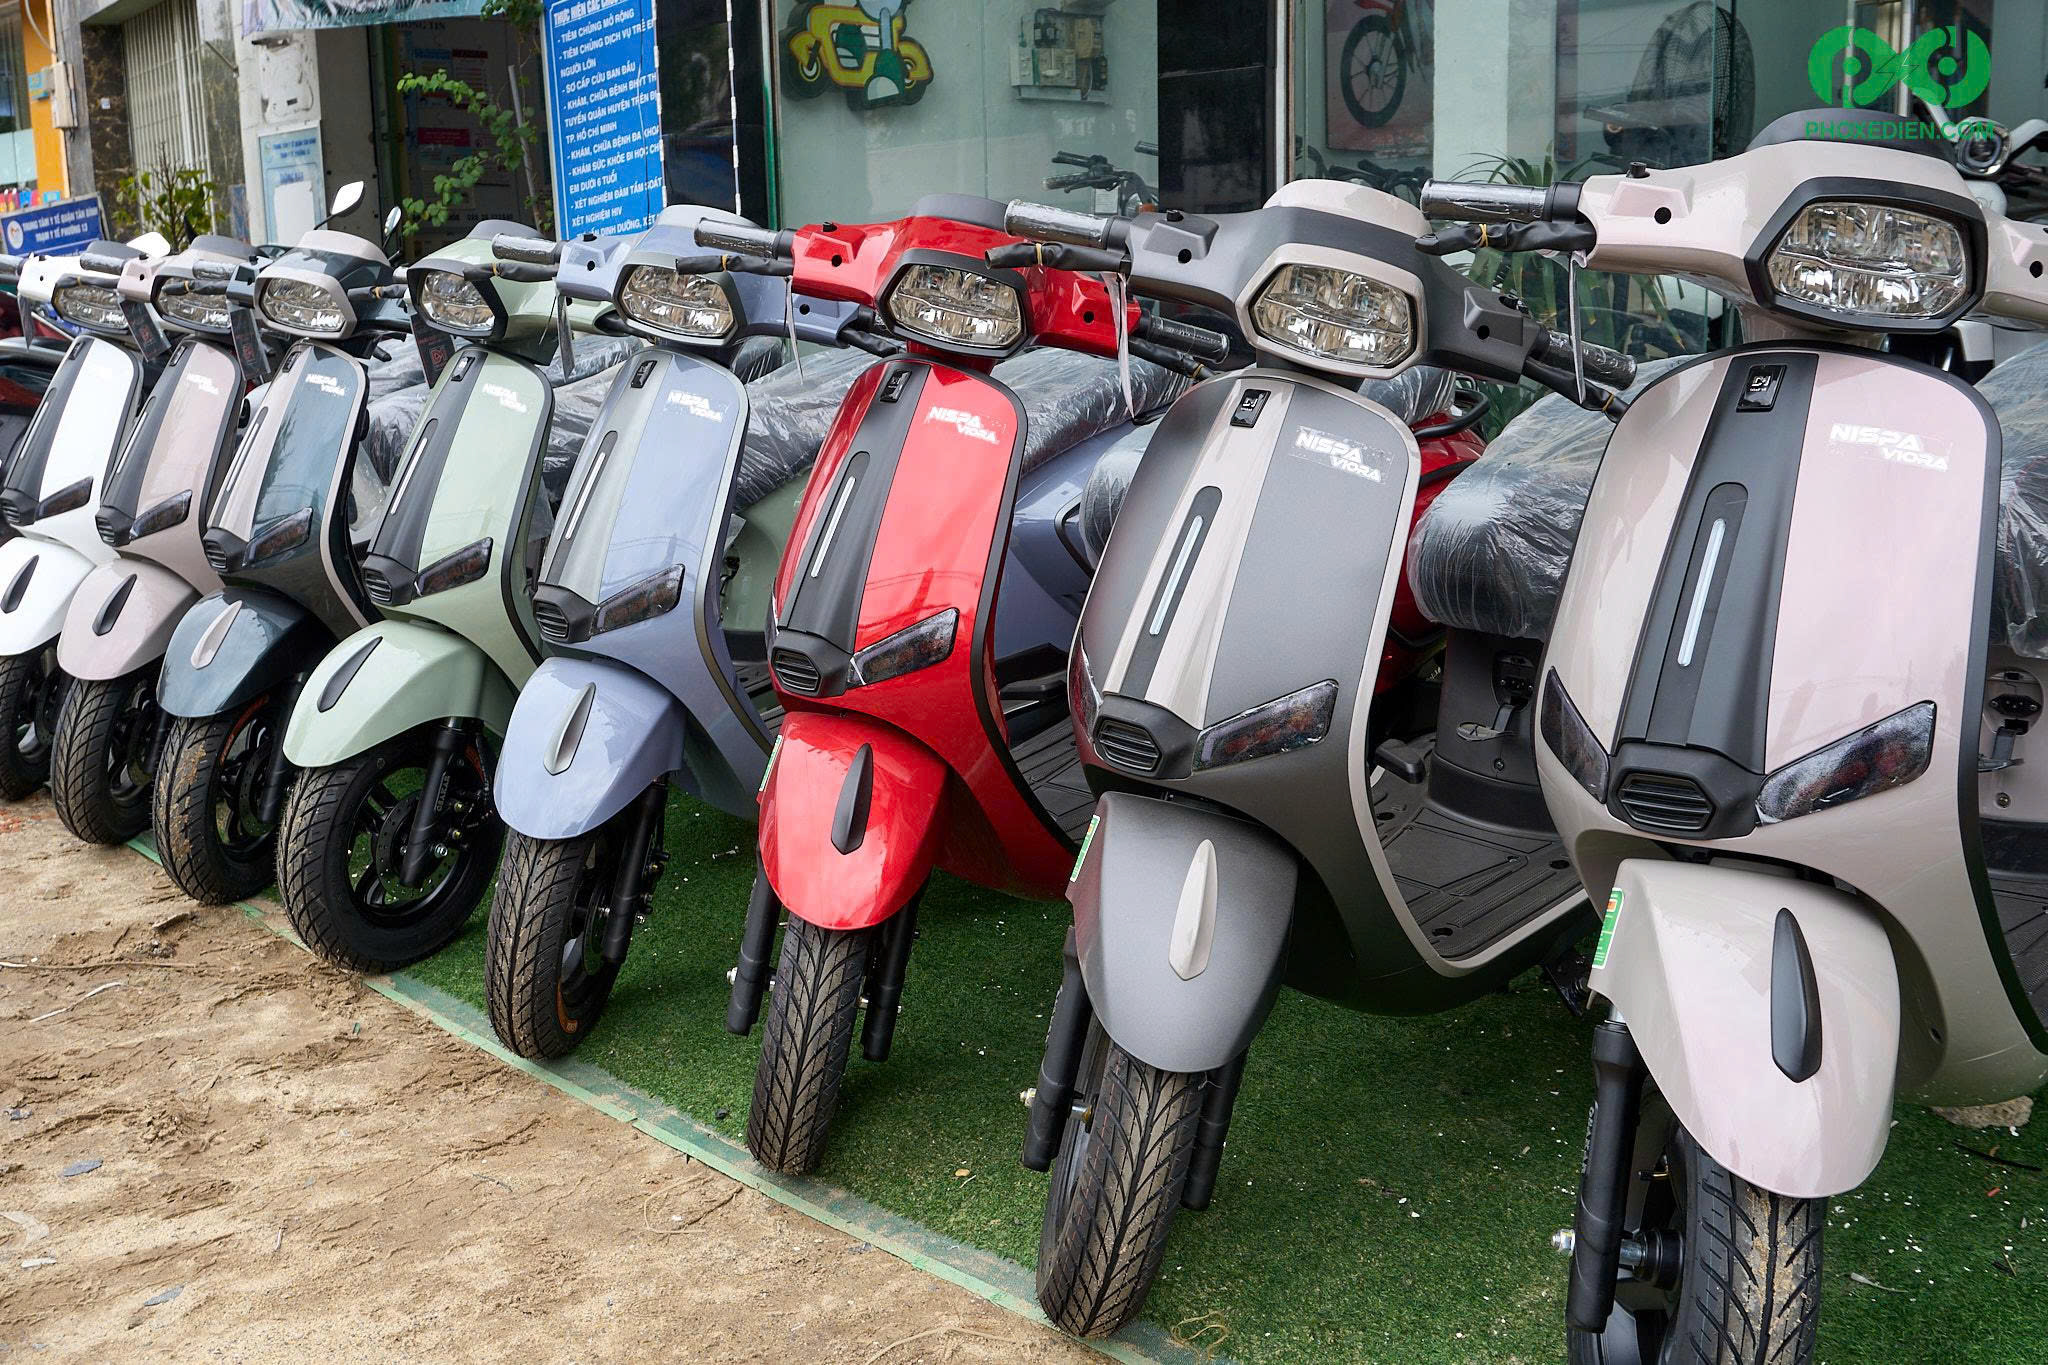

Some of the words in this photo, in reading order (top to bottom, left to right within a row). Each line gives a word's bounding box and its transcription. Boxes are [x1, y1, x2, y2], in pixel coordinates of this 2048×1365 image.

[607, 67, 620, 79] BAN
[600, 121, 617, 134] MINH
[1295, 433, 1362, 464] NISPA
[1830, 423, 1921, 452] NISPA
[1331, 455, 1382, 483] VIORA
[1883, 447, 1949, 472] VIORA
